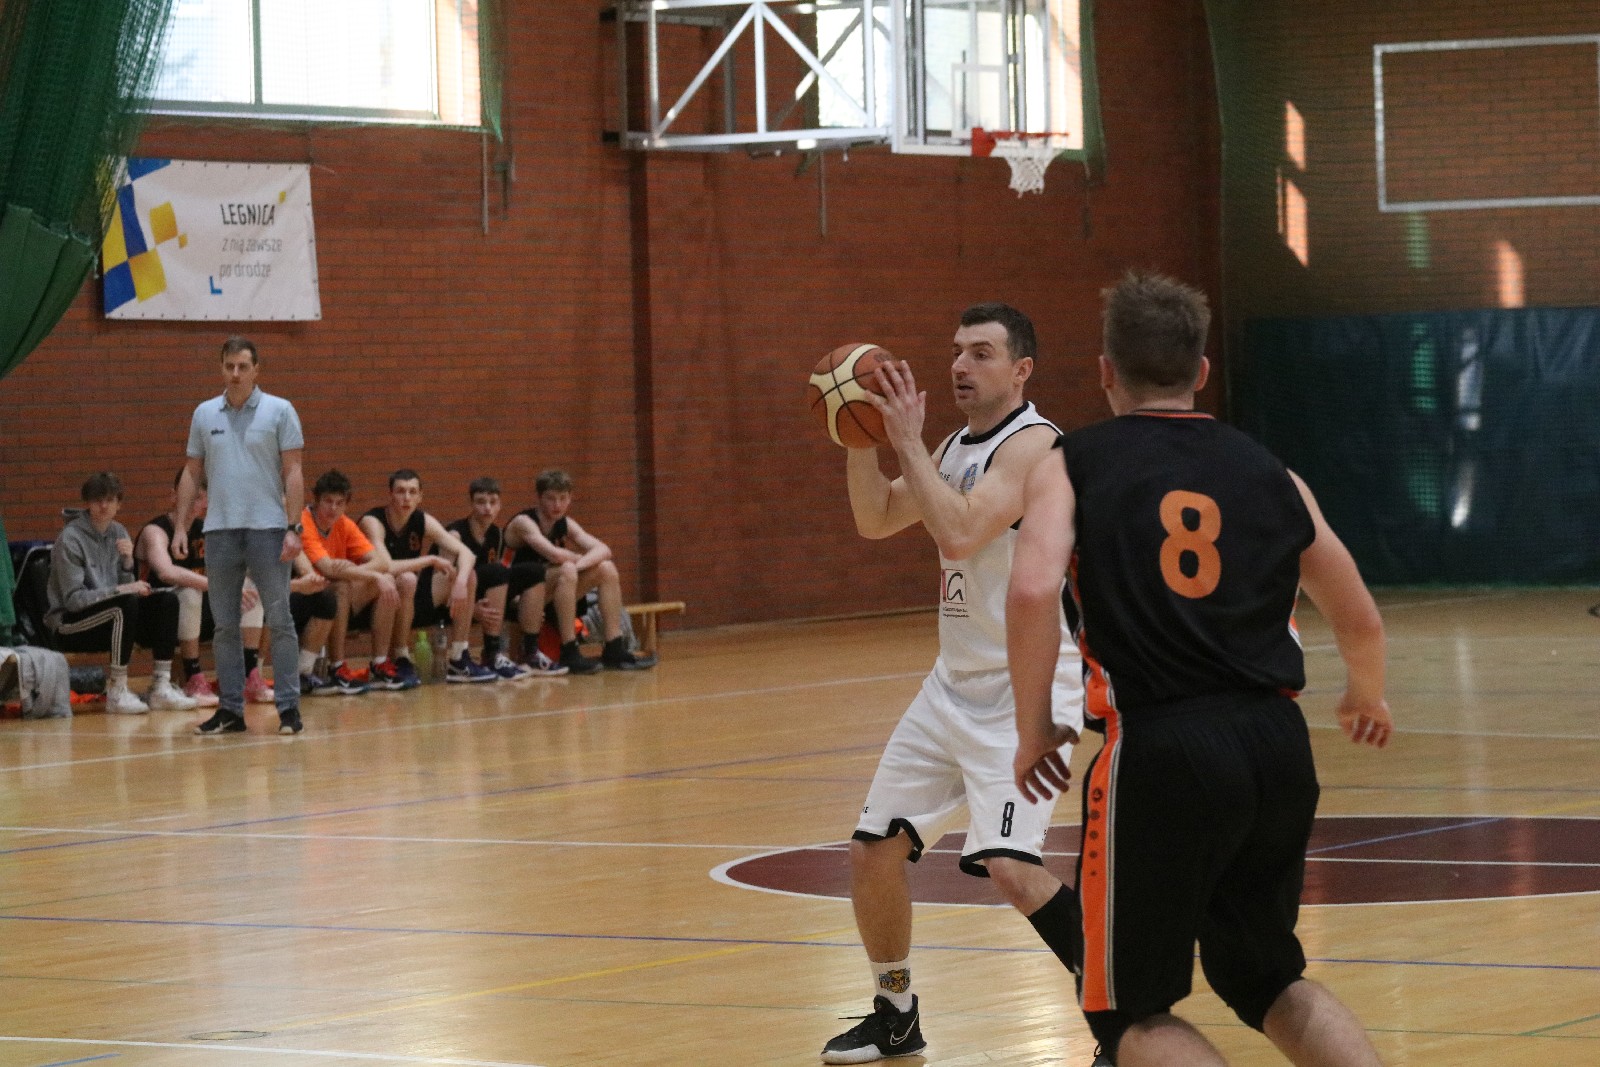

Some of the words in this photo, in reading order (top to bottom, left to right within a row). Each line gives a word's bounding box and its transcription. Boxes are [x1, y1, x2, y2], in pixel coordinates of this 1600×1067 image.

[220, 203, 275, 226] LEGNICA
[245, 238, 283, 253] zawsze
[219, 263, 232, 281] po
[234, 260, 272, 278] drodze
[1159, 490, 1222, 600] 8
[1000, 801, 1015, 838] 8
